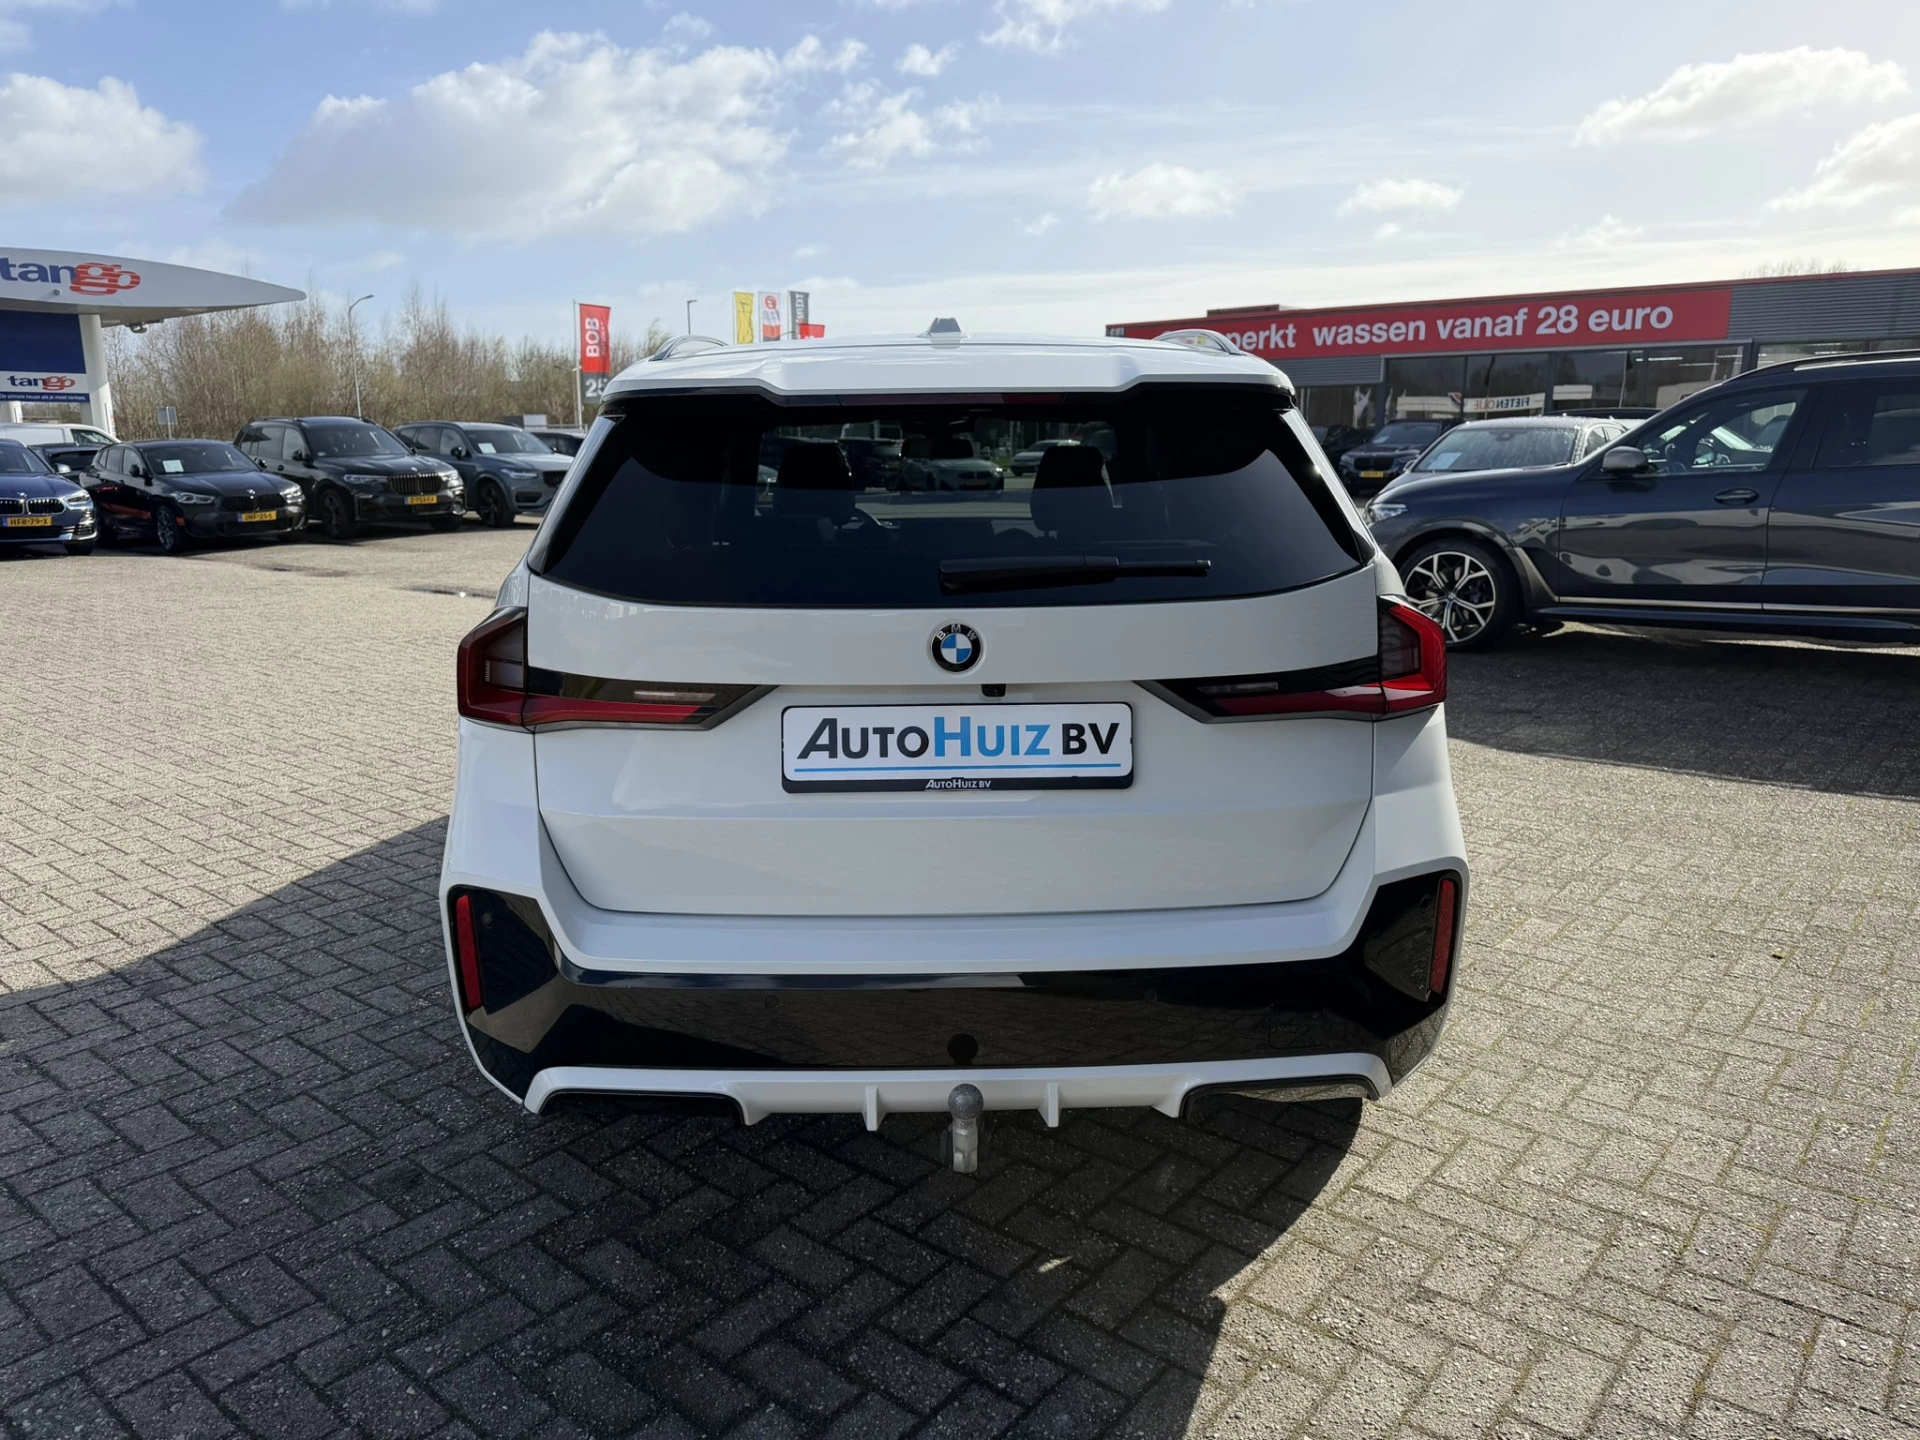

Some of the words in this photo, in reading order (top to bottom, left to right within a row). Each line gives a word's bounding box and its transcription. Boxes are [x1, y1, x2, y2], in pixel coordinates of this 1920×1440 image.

[0, 257, 141, 296] tango
[585, 317, 600, 358] BOB
[1225, 323, 1297, 351] perkt
[1312, 319, 1426, 346] wassen
[1436, 308, 1528, 340] vanaf
[1535, 304, 1579, 335] 28
[1588, 305, 1674, 333] euro
[7, 375, 76, 391] tango
[936, 624, 978, 641] BMW
[1061, 722, 1120, 755] BV
[978, 779, 992, 789] BV
